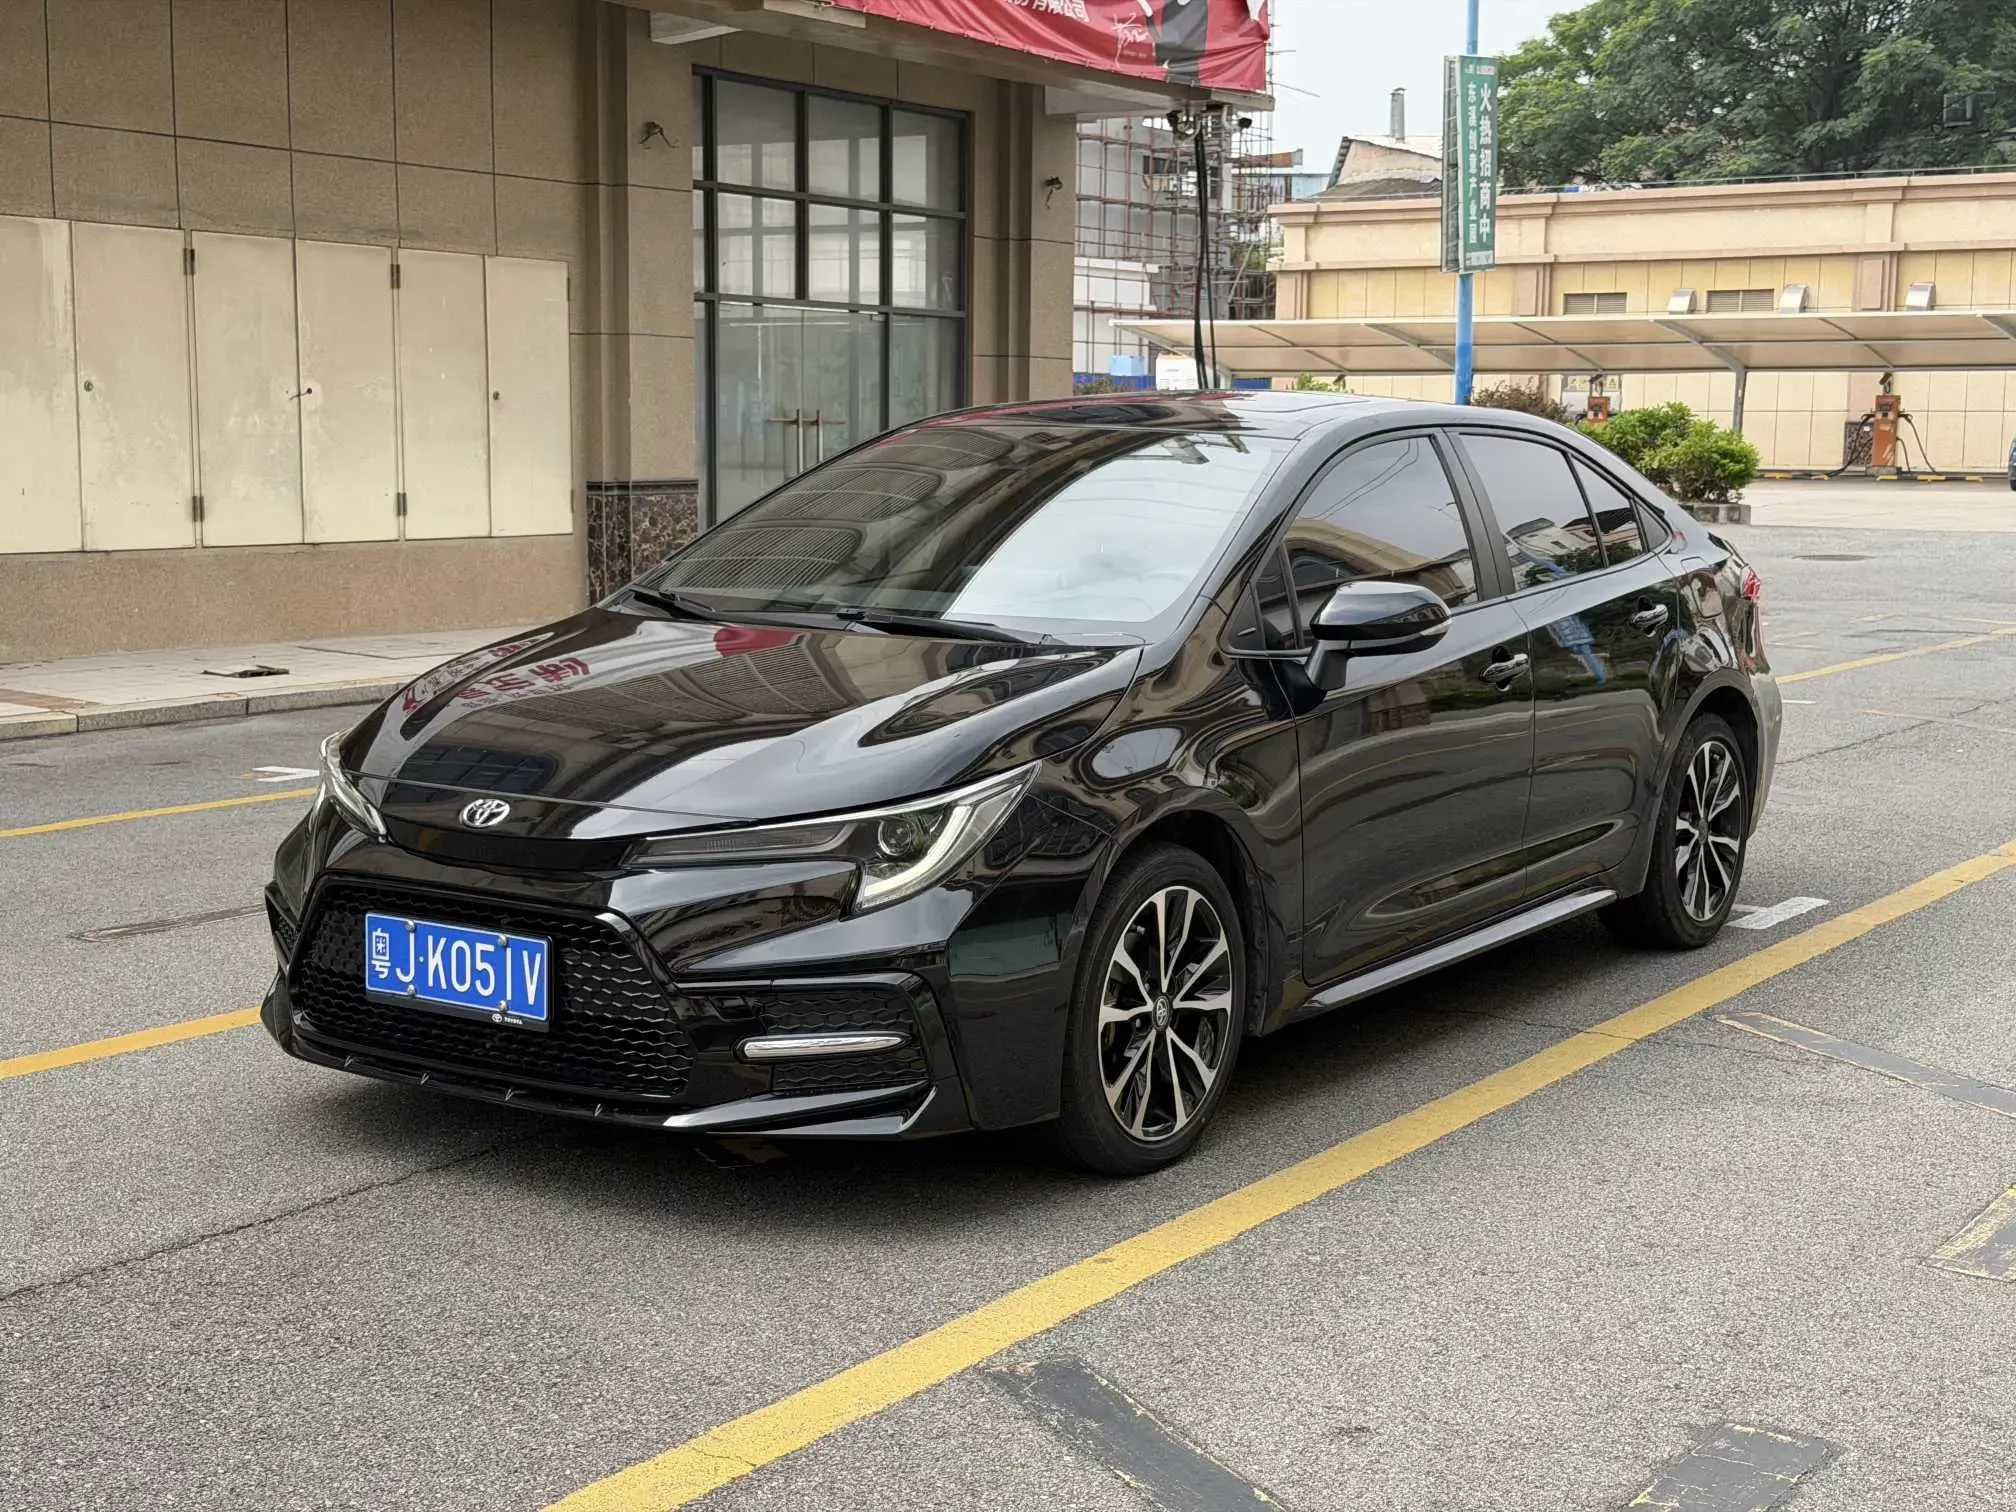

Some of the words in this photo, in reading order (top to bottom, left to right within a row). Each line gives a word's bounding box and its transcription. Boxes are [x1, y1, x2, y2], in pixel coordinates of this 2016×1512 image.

[1007, 0, 1090, 22] 有限公司
[1479, 82, 1492, 243] 火热招商中
